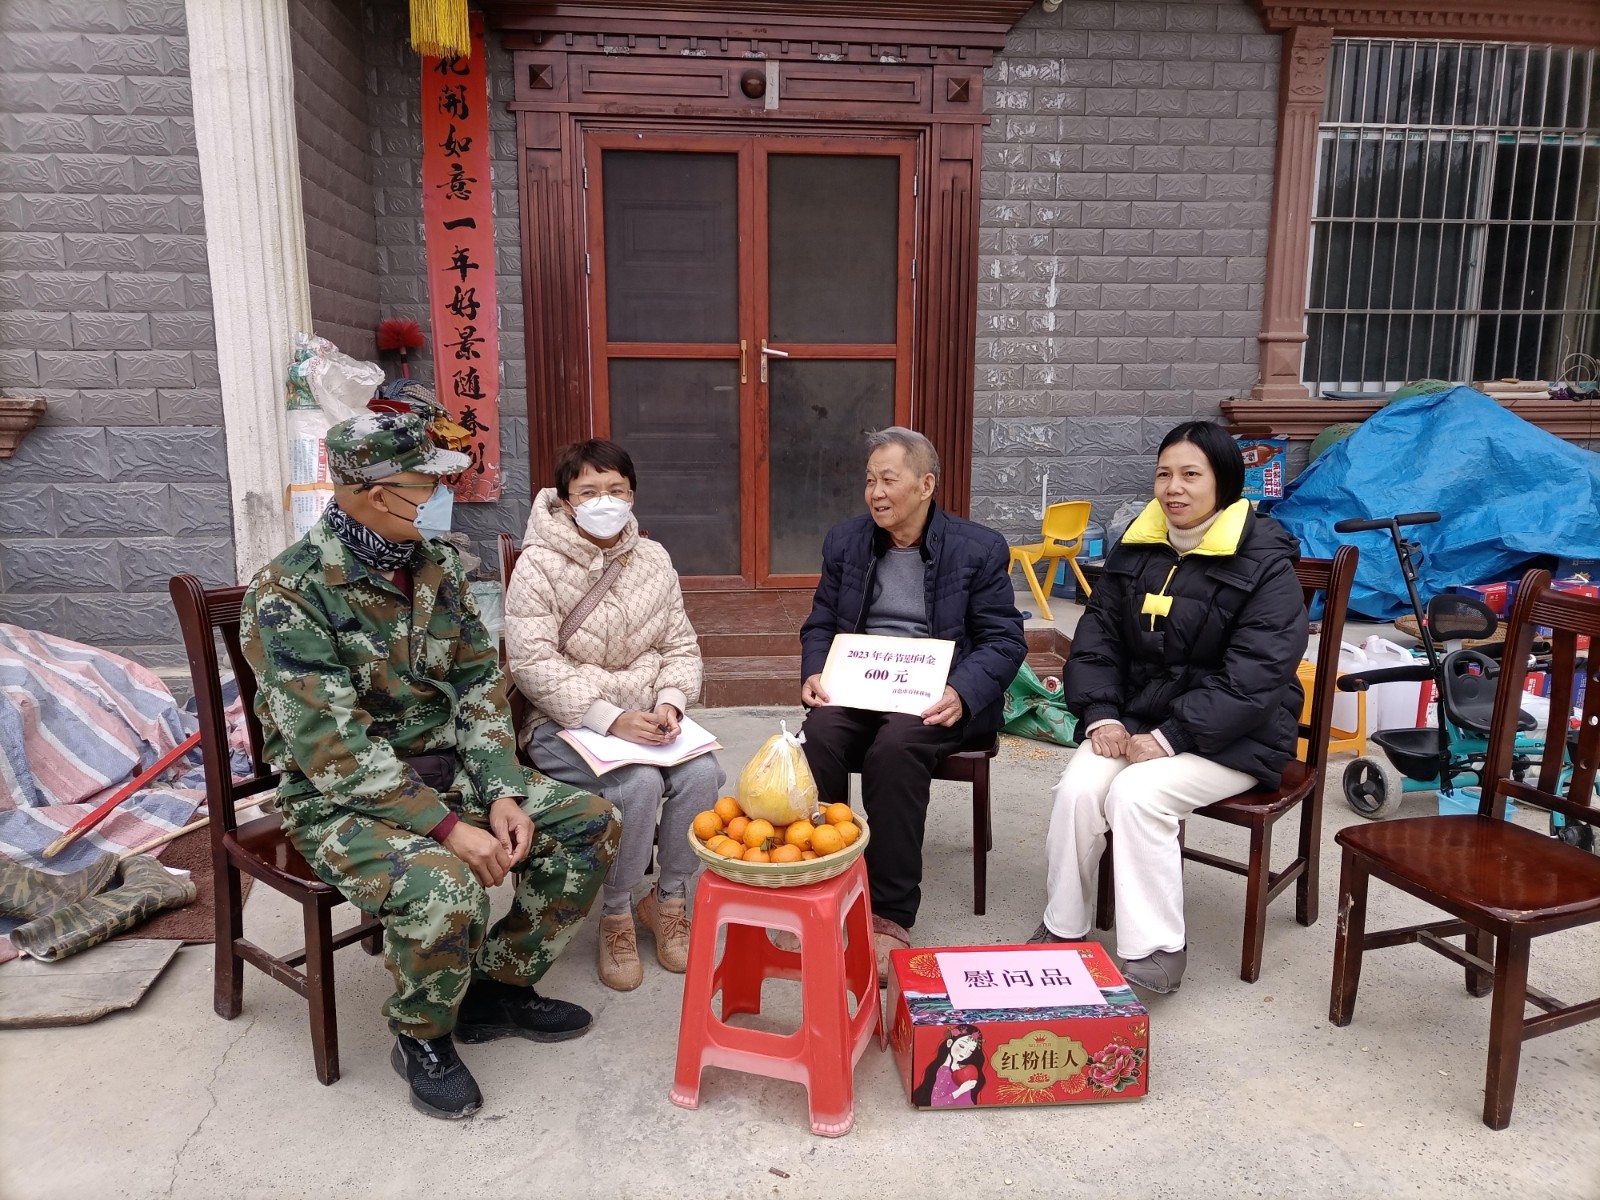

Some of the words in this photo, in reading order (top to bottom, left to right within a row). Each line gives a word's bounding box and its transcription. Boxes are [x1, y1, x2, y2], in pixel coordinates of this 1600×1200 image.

[847, 650, 869, 659] 2023
[872, 650, 936, 666] 年春节慰问金
[864, 668, 889, 681] 600
[892, 669, 909, 683] 元
[963, 968, 1073, 988] 慰问品
[1001, 1048, 1080, 1071] 红粉佳人
